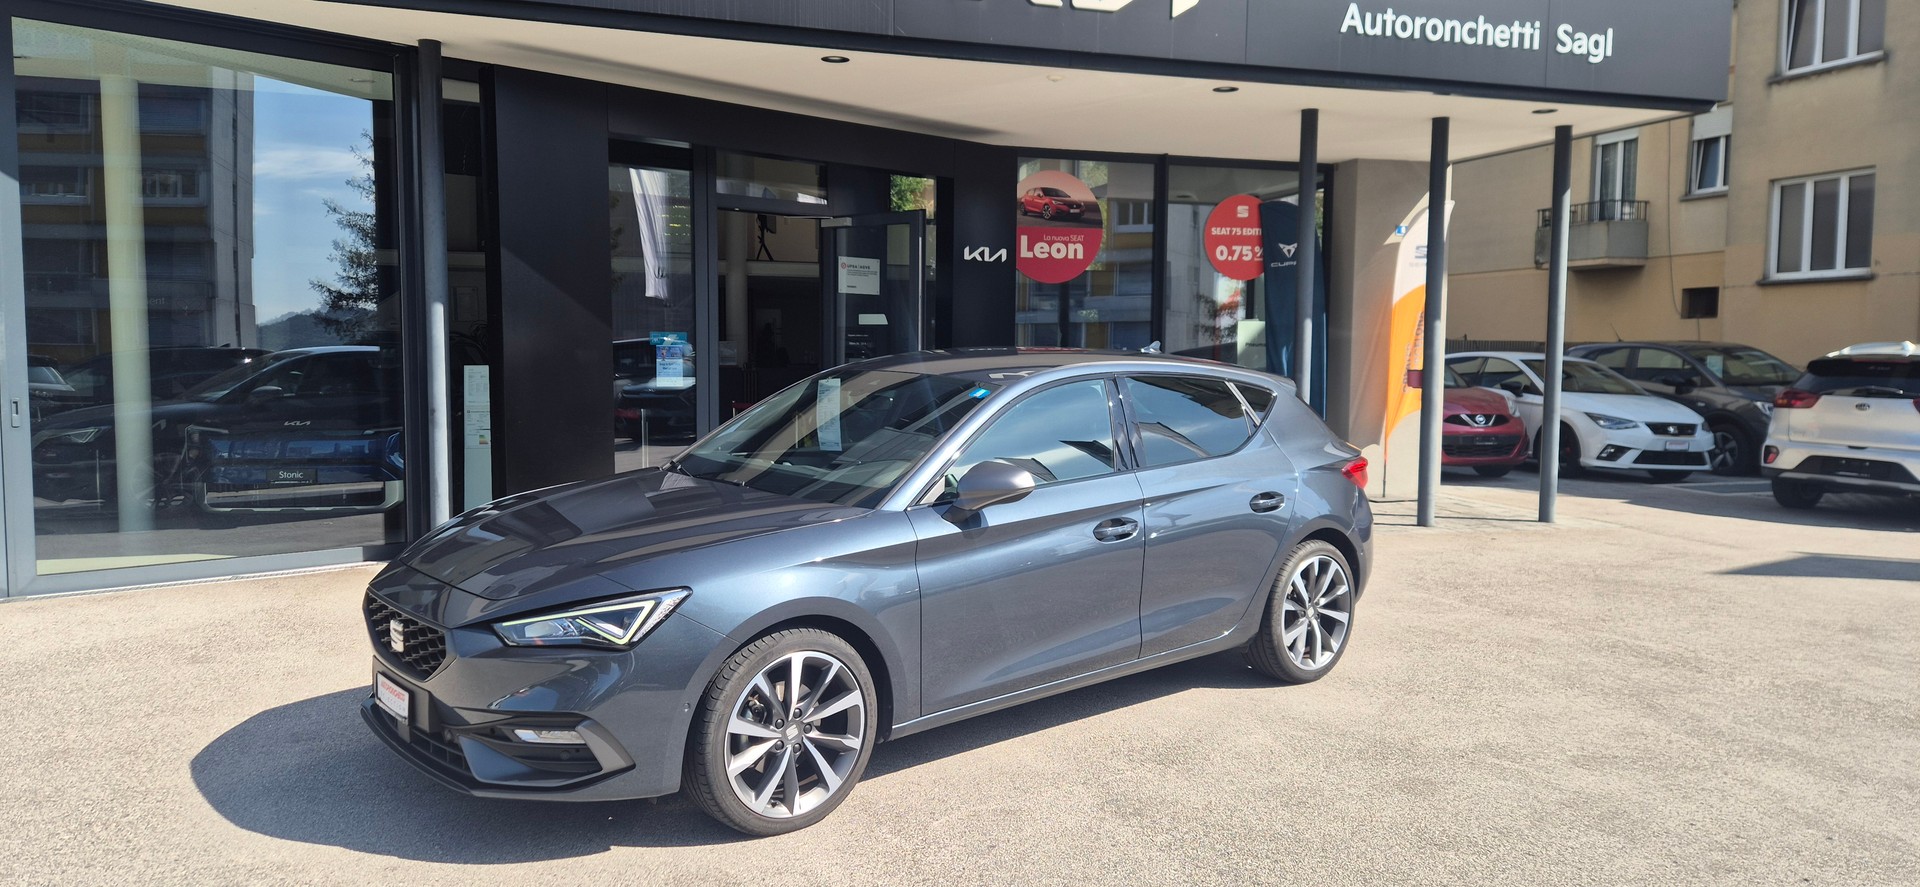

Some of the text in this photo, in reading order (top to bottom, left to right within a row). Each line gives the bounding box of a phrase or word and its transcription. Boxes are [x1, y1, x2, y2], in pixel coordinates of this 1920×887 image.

[1340, 2, 1613, 64] Autoronchetti Sagl
[1211, 227, 1230, 236] SEAT
[1232, 227, 1242, 236] 75
[963, 245, 1007, 263] KIA
[1020, 235, 1084, 260] Leon
[1215, 245, 1253, 262] 0.75
[278, 470, 304, 479] Stonic
